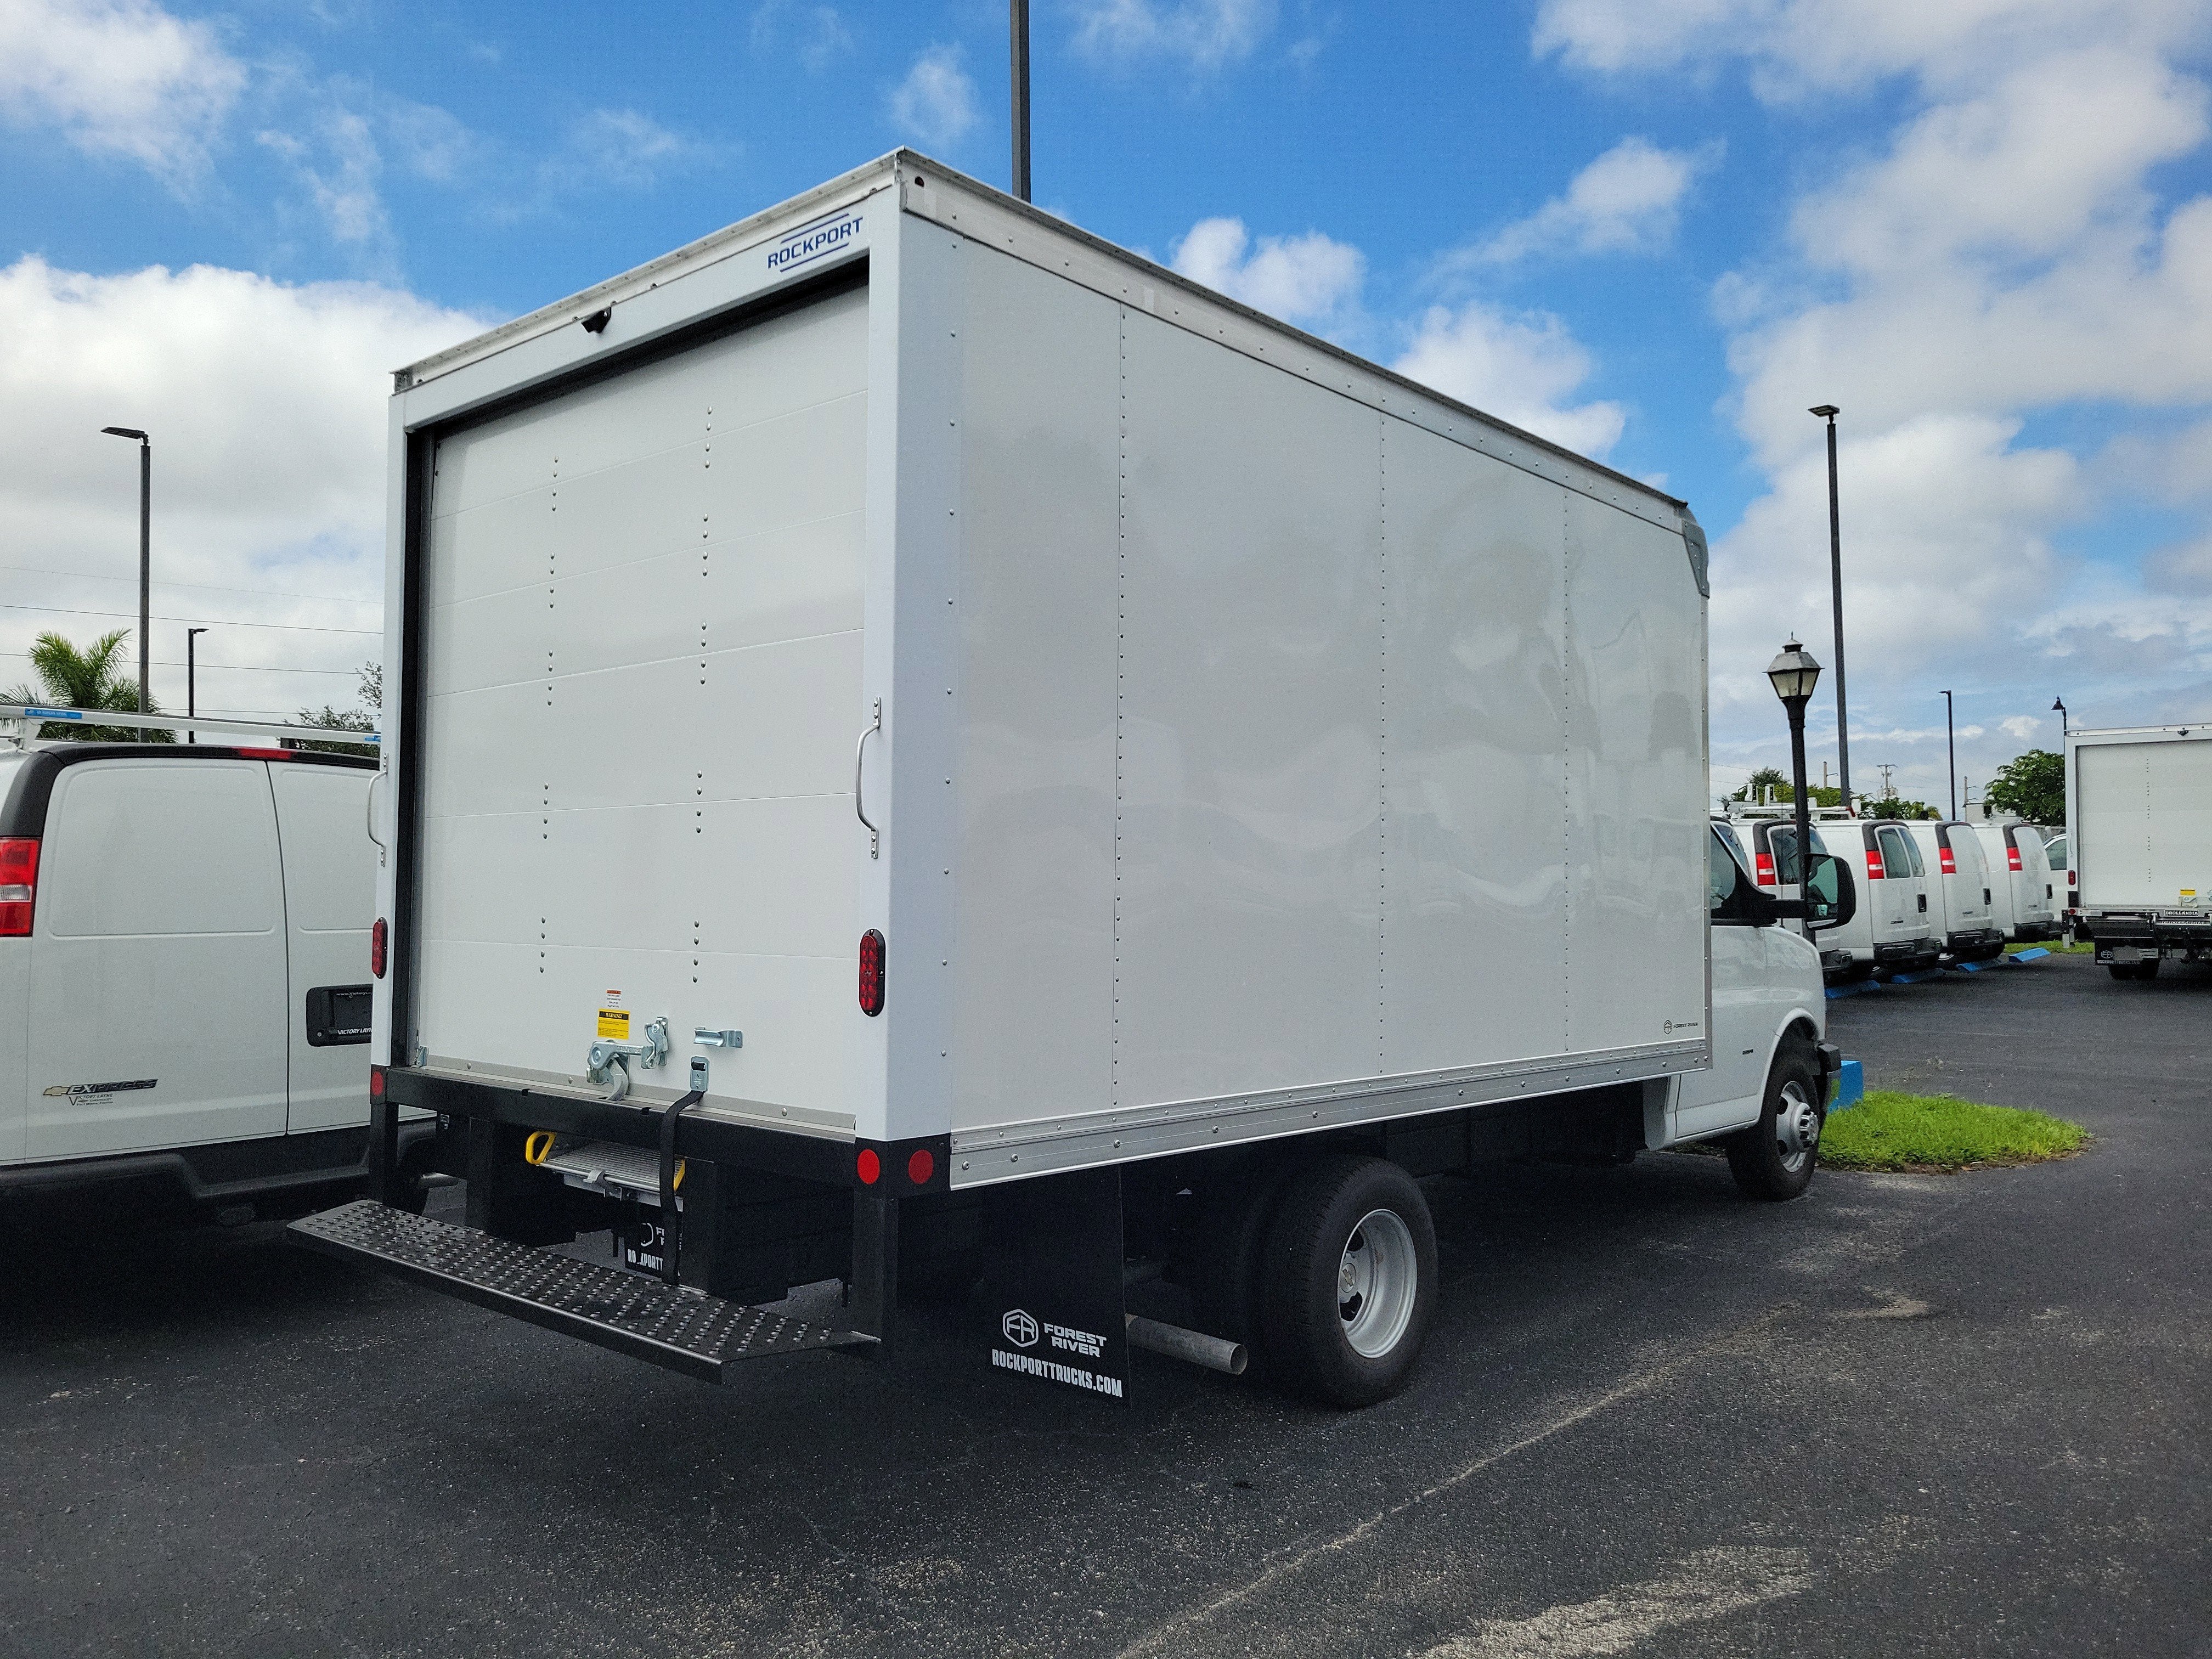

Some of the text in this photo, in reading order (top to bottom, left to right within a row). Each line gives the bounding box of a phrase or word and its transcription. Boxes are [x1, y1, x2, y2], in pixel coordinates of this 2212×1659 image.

[768, 216, 863, 269] ROCKPORT
[67, 1079, 158, 1094] EXPRESS
[1043, 1322, 1107, 1347] FOREST
[1051, 1335, 1101, 1358] RIVER
[992, 1348, 1122, 1398] ROCKPORTTRUCKS.COM
